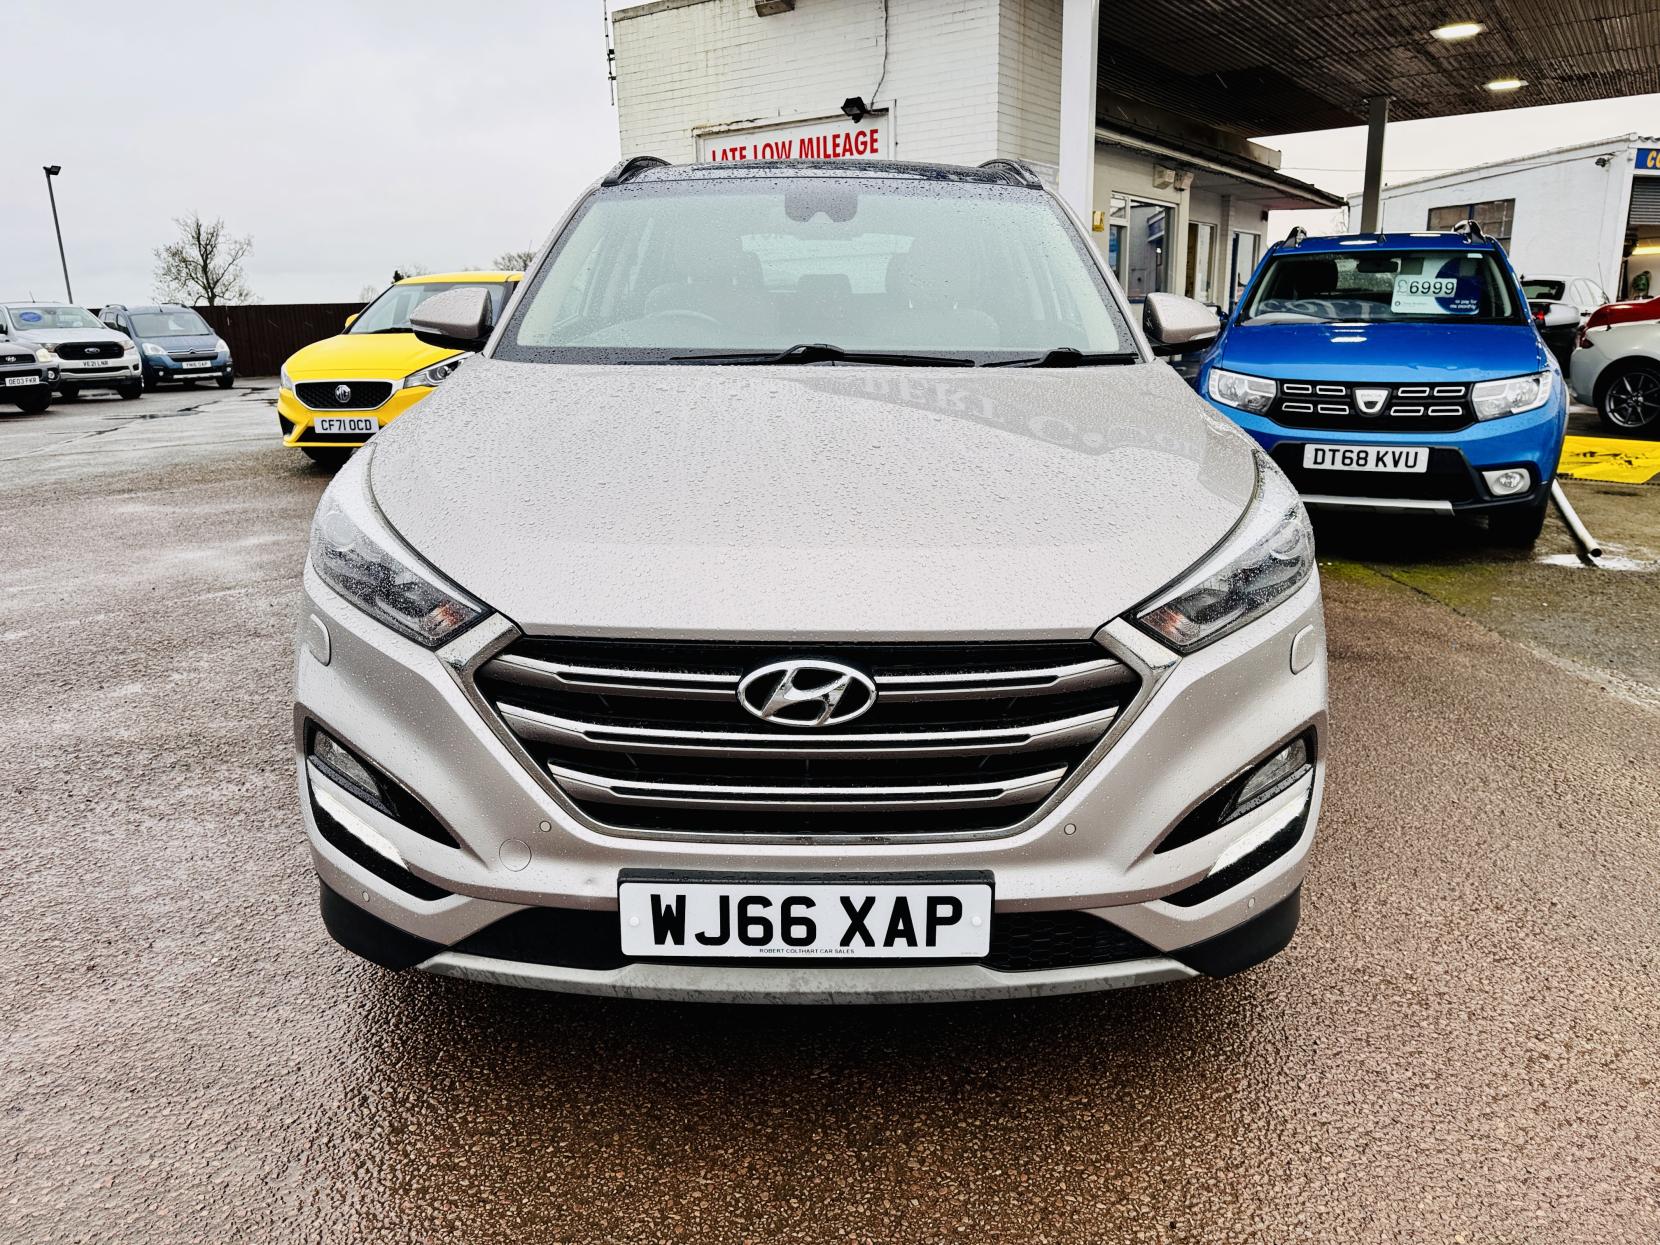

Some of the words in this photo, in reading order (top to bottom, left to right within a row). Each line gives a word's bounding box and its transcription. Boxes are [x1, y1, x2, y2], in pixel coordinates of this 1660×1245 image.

[799, 129, 879, 159] MILEAGE
[320, 419, 347, 431] CF71
[349, 419, 372, 431] OCD
[1312, 448, 1369, 467] DT68
[1375, 451, 1419, 469] KVU
[651, 894, 817, 947] WJ66
[839, 896, 963, 947] XAP
